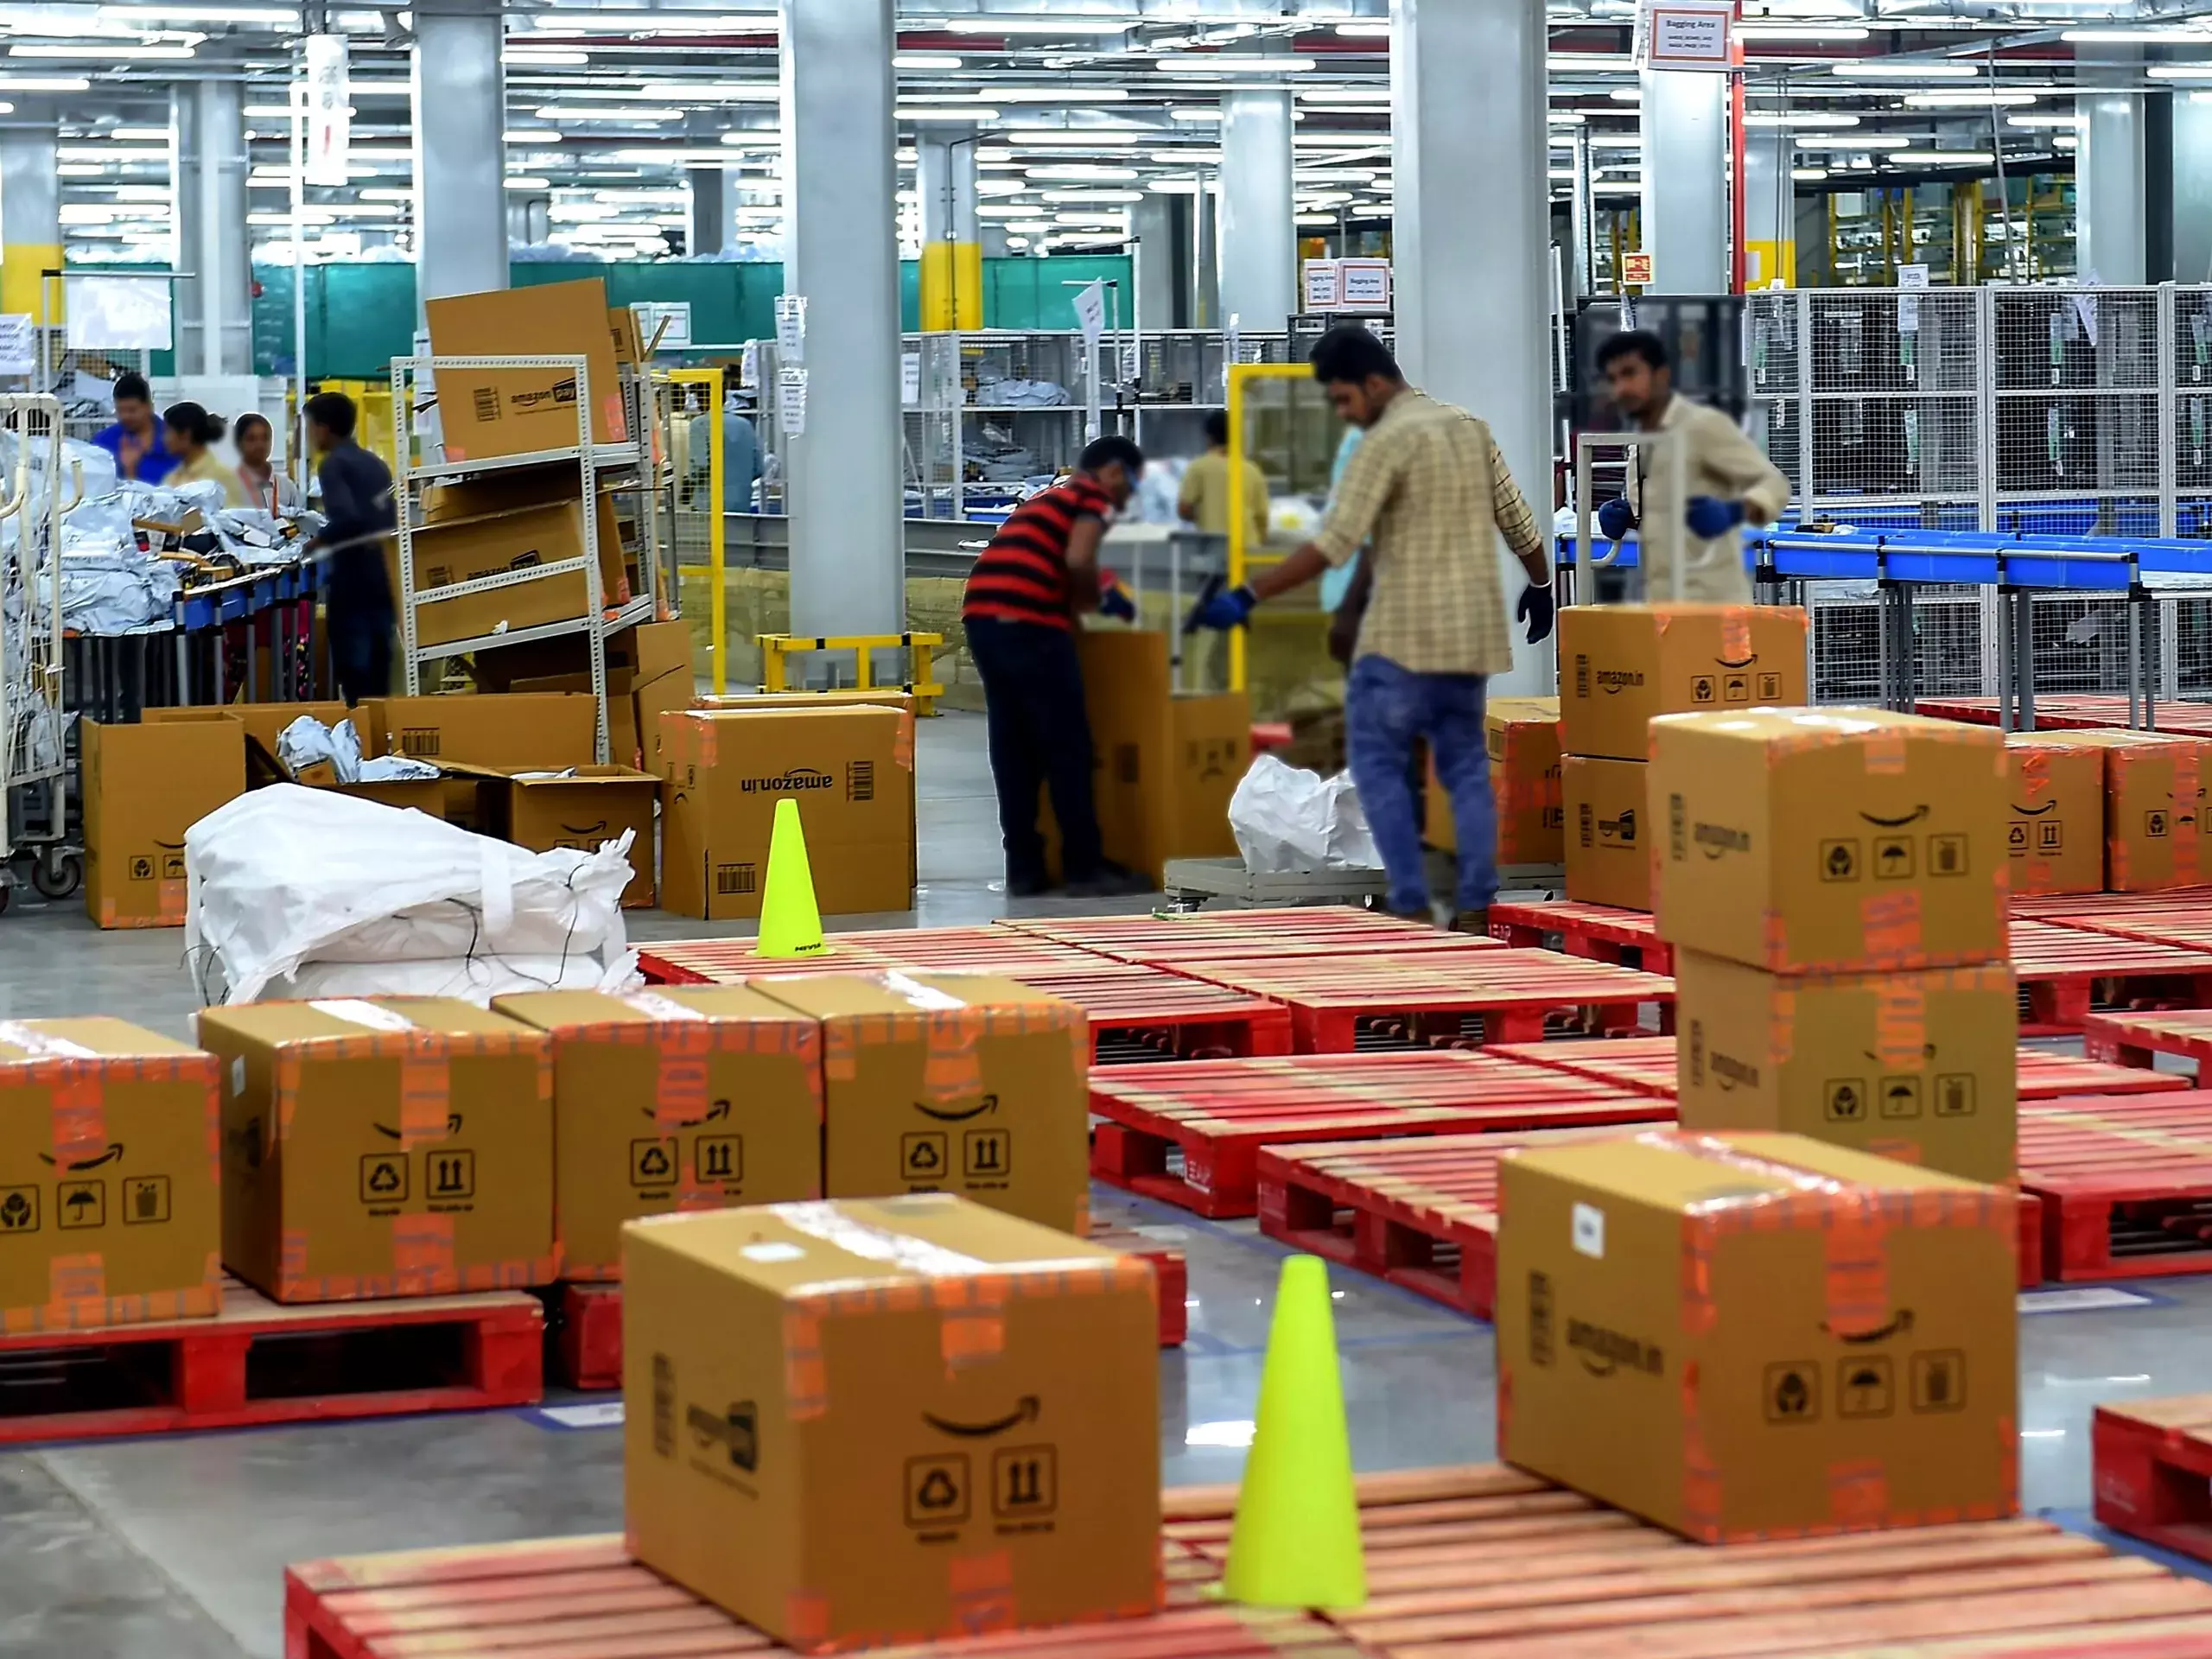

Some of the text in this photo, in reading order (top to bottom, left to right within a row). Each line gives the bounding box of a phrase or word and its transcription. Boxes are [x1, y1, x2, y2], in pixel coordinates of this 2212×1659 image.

[1666, 20, 1696, 29] Bagging
[511, 391, 551, 404] amazon
[1597, 670, 1644, 686] amazon.in
[741, 775, 833, 794] amazon.in
